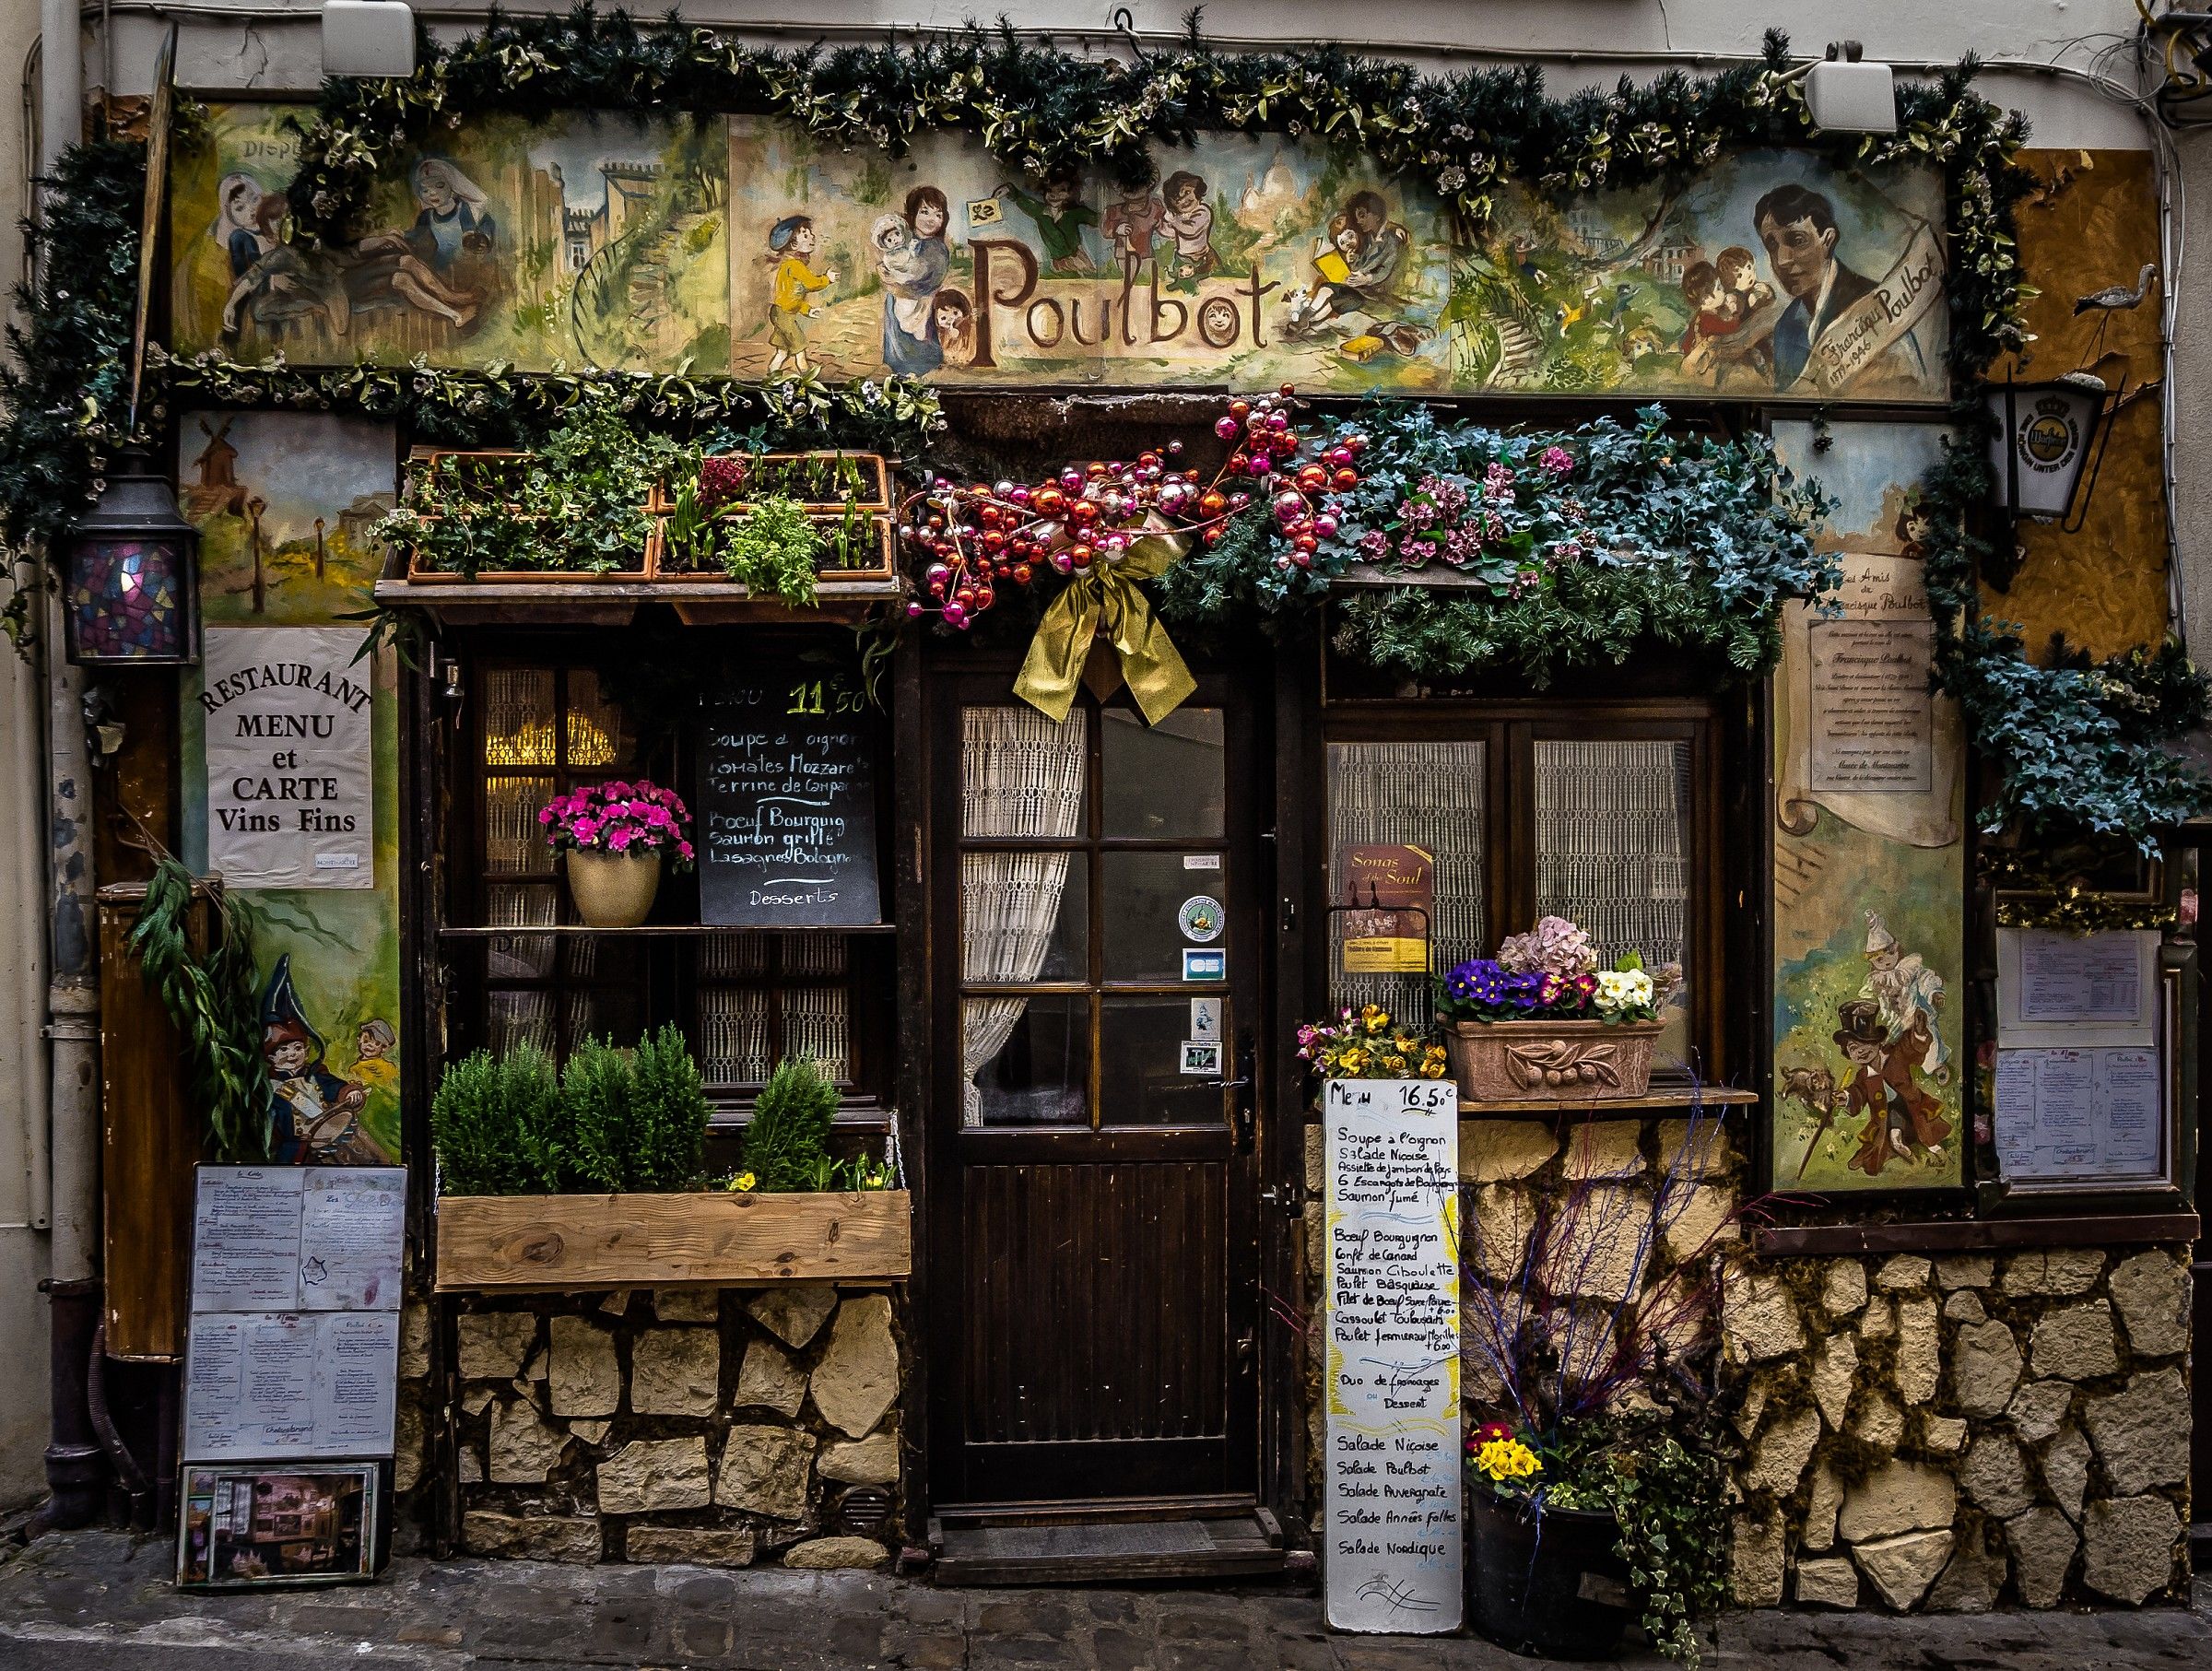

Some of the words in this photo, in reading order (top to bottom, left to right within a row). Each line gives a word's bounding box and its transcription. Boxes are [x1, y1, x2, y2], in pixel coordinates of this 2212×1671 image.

[1873, 252, 1938, 324] Poulbot
[968, 239, 1281, 368] Poulbot
[2033, 463, 2060, 473] UNTER
[1860, 568, 1890, 582] Amis
[197, 663, 373, 715] RESTAURANT
[235, 714, 335, 737] MENU
[273, 749, 298, 769] et
[232, 777, 338, 800] CARTE
[782, 777, 800, 793] de
[216, 806, 280, 831] Vins
[298, 806, 356, 831] Fins
[782, 827, 834, 858] grillé
[1385, 866, 1422, 885] Soul
[750, 888, 838, 906] Desserts
[1337, 1126, 1382, 1148] Soupe
[1400, 1132, 1446, 1152] l'oignon
[1339, 1147, 1385, 1160] Salade
[1338, 1161, 1375, 1172] Assiette
[1376, 1162, 1386, 1172] de
[1385, 1164, 1423, 1179] jambon
[1424, 1162, 1433, 1173] de
[1337, 1174, 1348, 1186] 6
[1353, 1176, 1404, 1194] Escargots
[1405, 1178, 1415, 1187] de
[1337, 1189, 1385, 1202] Saumon
[1389, 1190, 1419, 1212] fumé
[1373, 1230, 1438, 1250] Bourguignon
[1369, 1248, 1381, 1260] de
[1382, 1249, 1418, 1261] Canard
[1337, 1263, 1382, 1276] Saumon
[1386, 1263, 1454, 1277] Ciboulette
[1336, 1276, 1368, 1289] Poulet
[1336, 1291, 1359, 1306] Filet
[1363, 1292, 1374, 1305] de
[1335, 1311, 1387, 1324] Cassoulet
[1335, 1326, 1371, 1342] Poulet
[1340, 1373, 1364, 1385] Duo
[1373, 1373, 1387, 1386] de
[1383, 1396, 1428, 1409] Dessert
[1336, 1433, 1386, 1452] Salade
[1395, 1438, 1440, 1454] Niçoise
[1336, 1460, 1377, 1475] Salade
[1385, 1461, 1431, 1476] Poulbot
[1337, 1482, 1380, 1498] Salade
[1383, 1484, 1448, 1504] Auvergnate
[1337, 1508, 1382, 1524] Salade
[1338, 1538, 1381, 1555] Salade
[1386, 1541, 1446, 1562] Nordique
